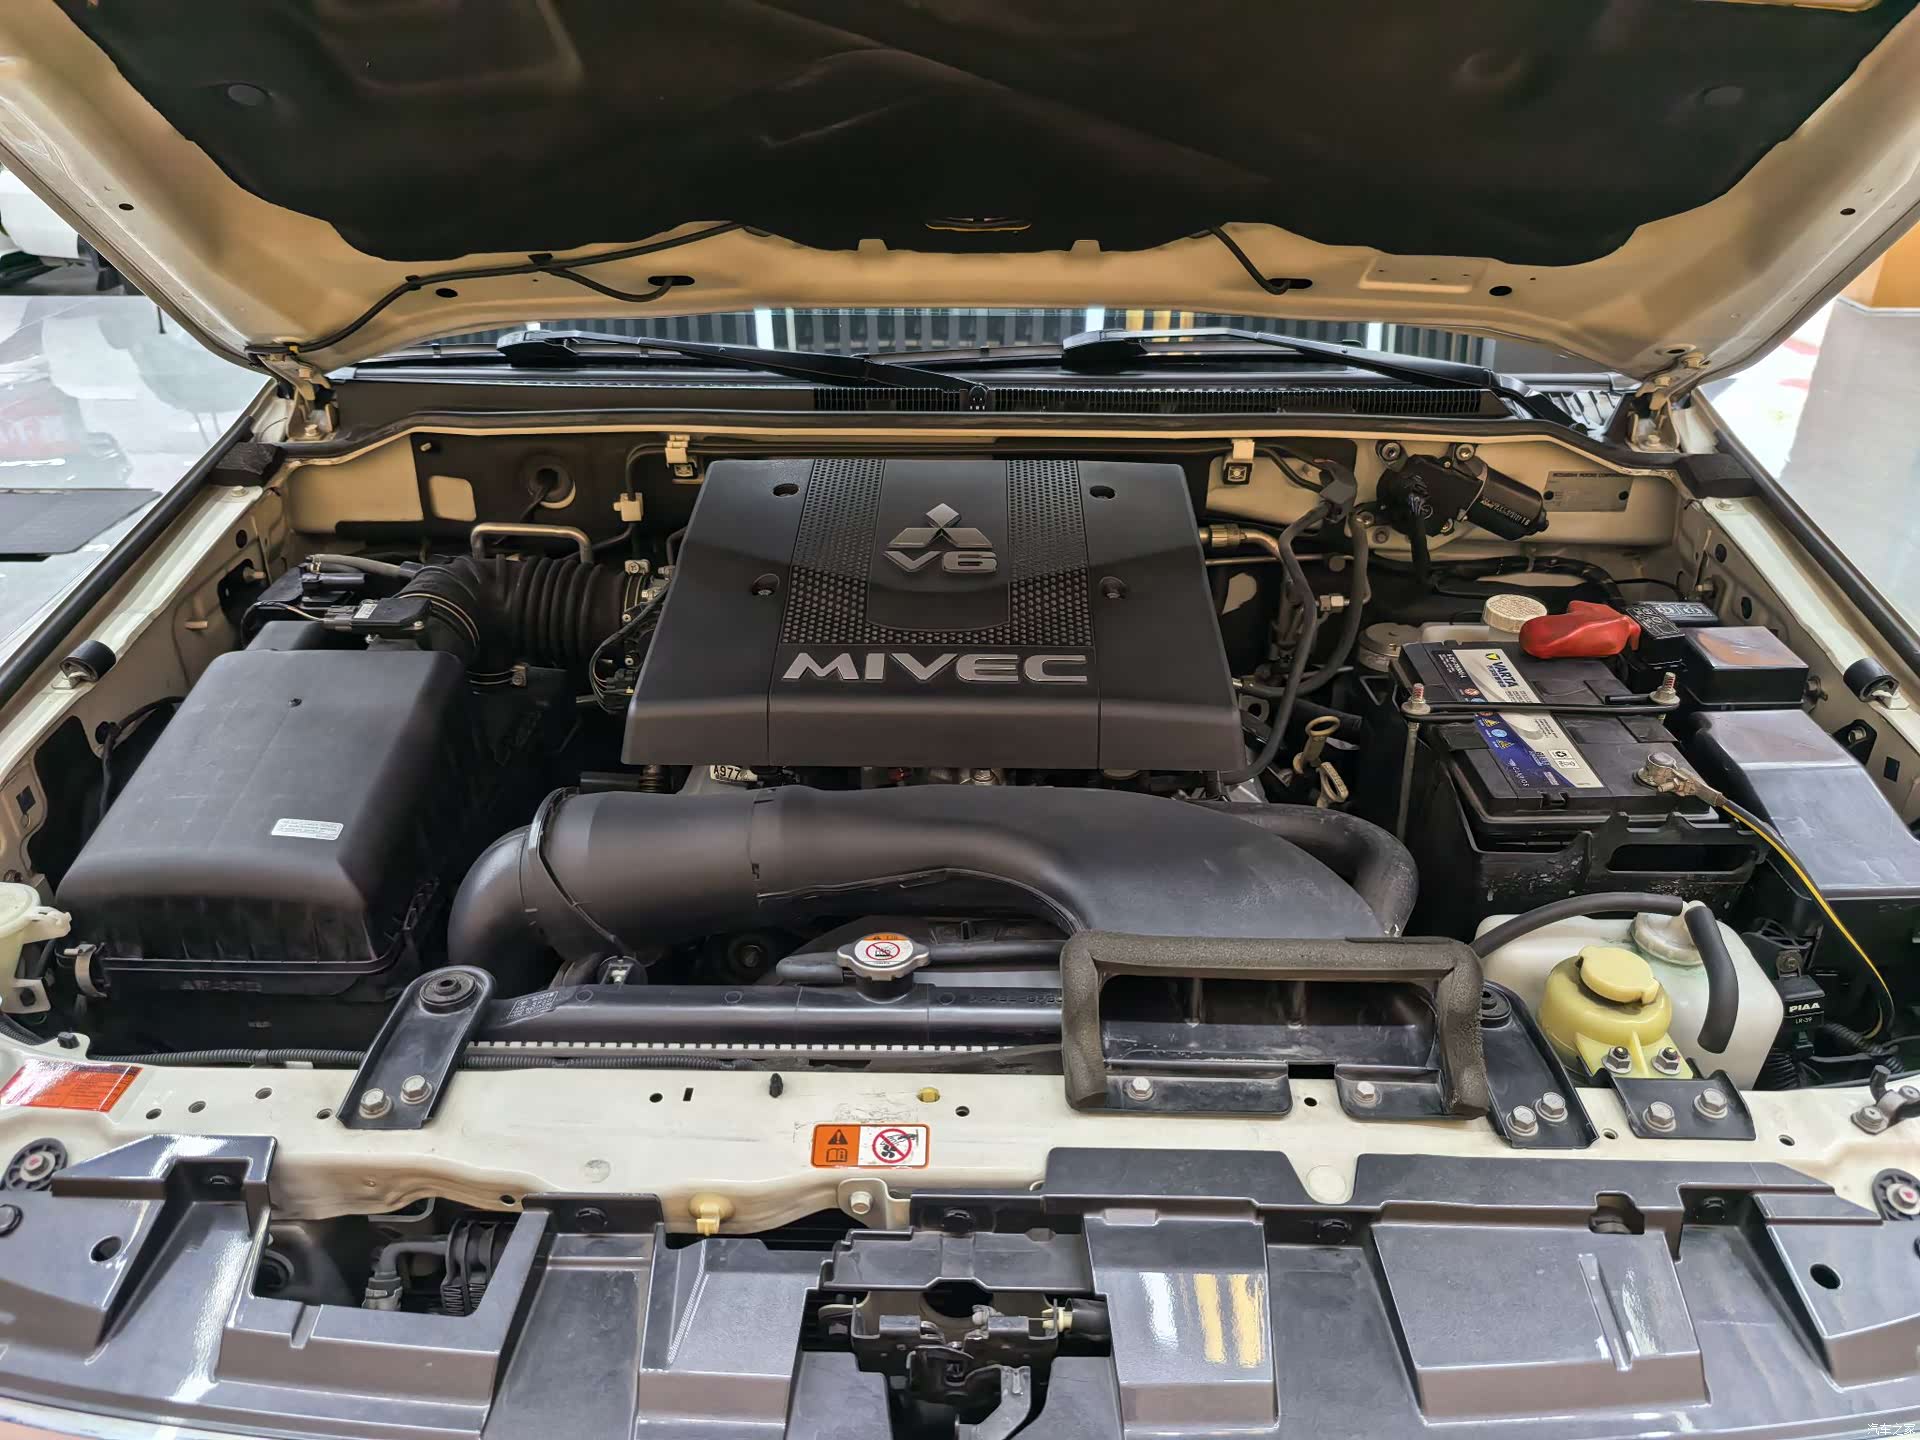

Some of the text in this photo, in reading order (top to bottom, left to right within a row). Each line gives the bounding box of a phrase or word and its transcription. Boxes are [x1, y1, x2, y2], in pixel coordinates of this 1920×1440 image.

[883, 550, 998, 574] V6
[782, 652, 1088, 683] MIVEC
[1493, 661, 1519, 688] VARTA
[1789, 1002, 1820, 1013] PIAA
